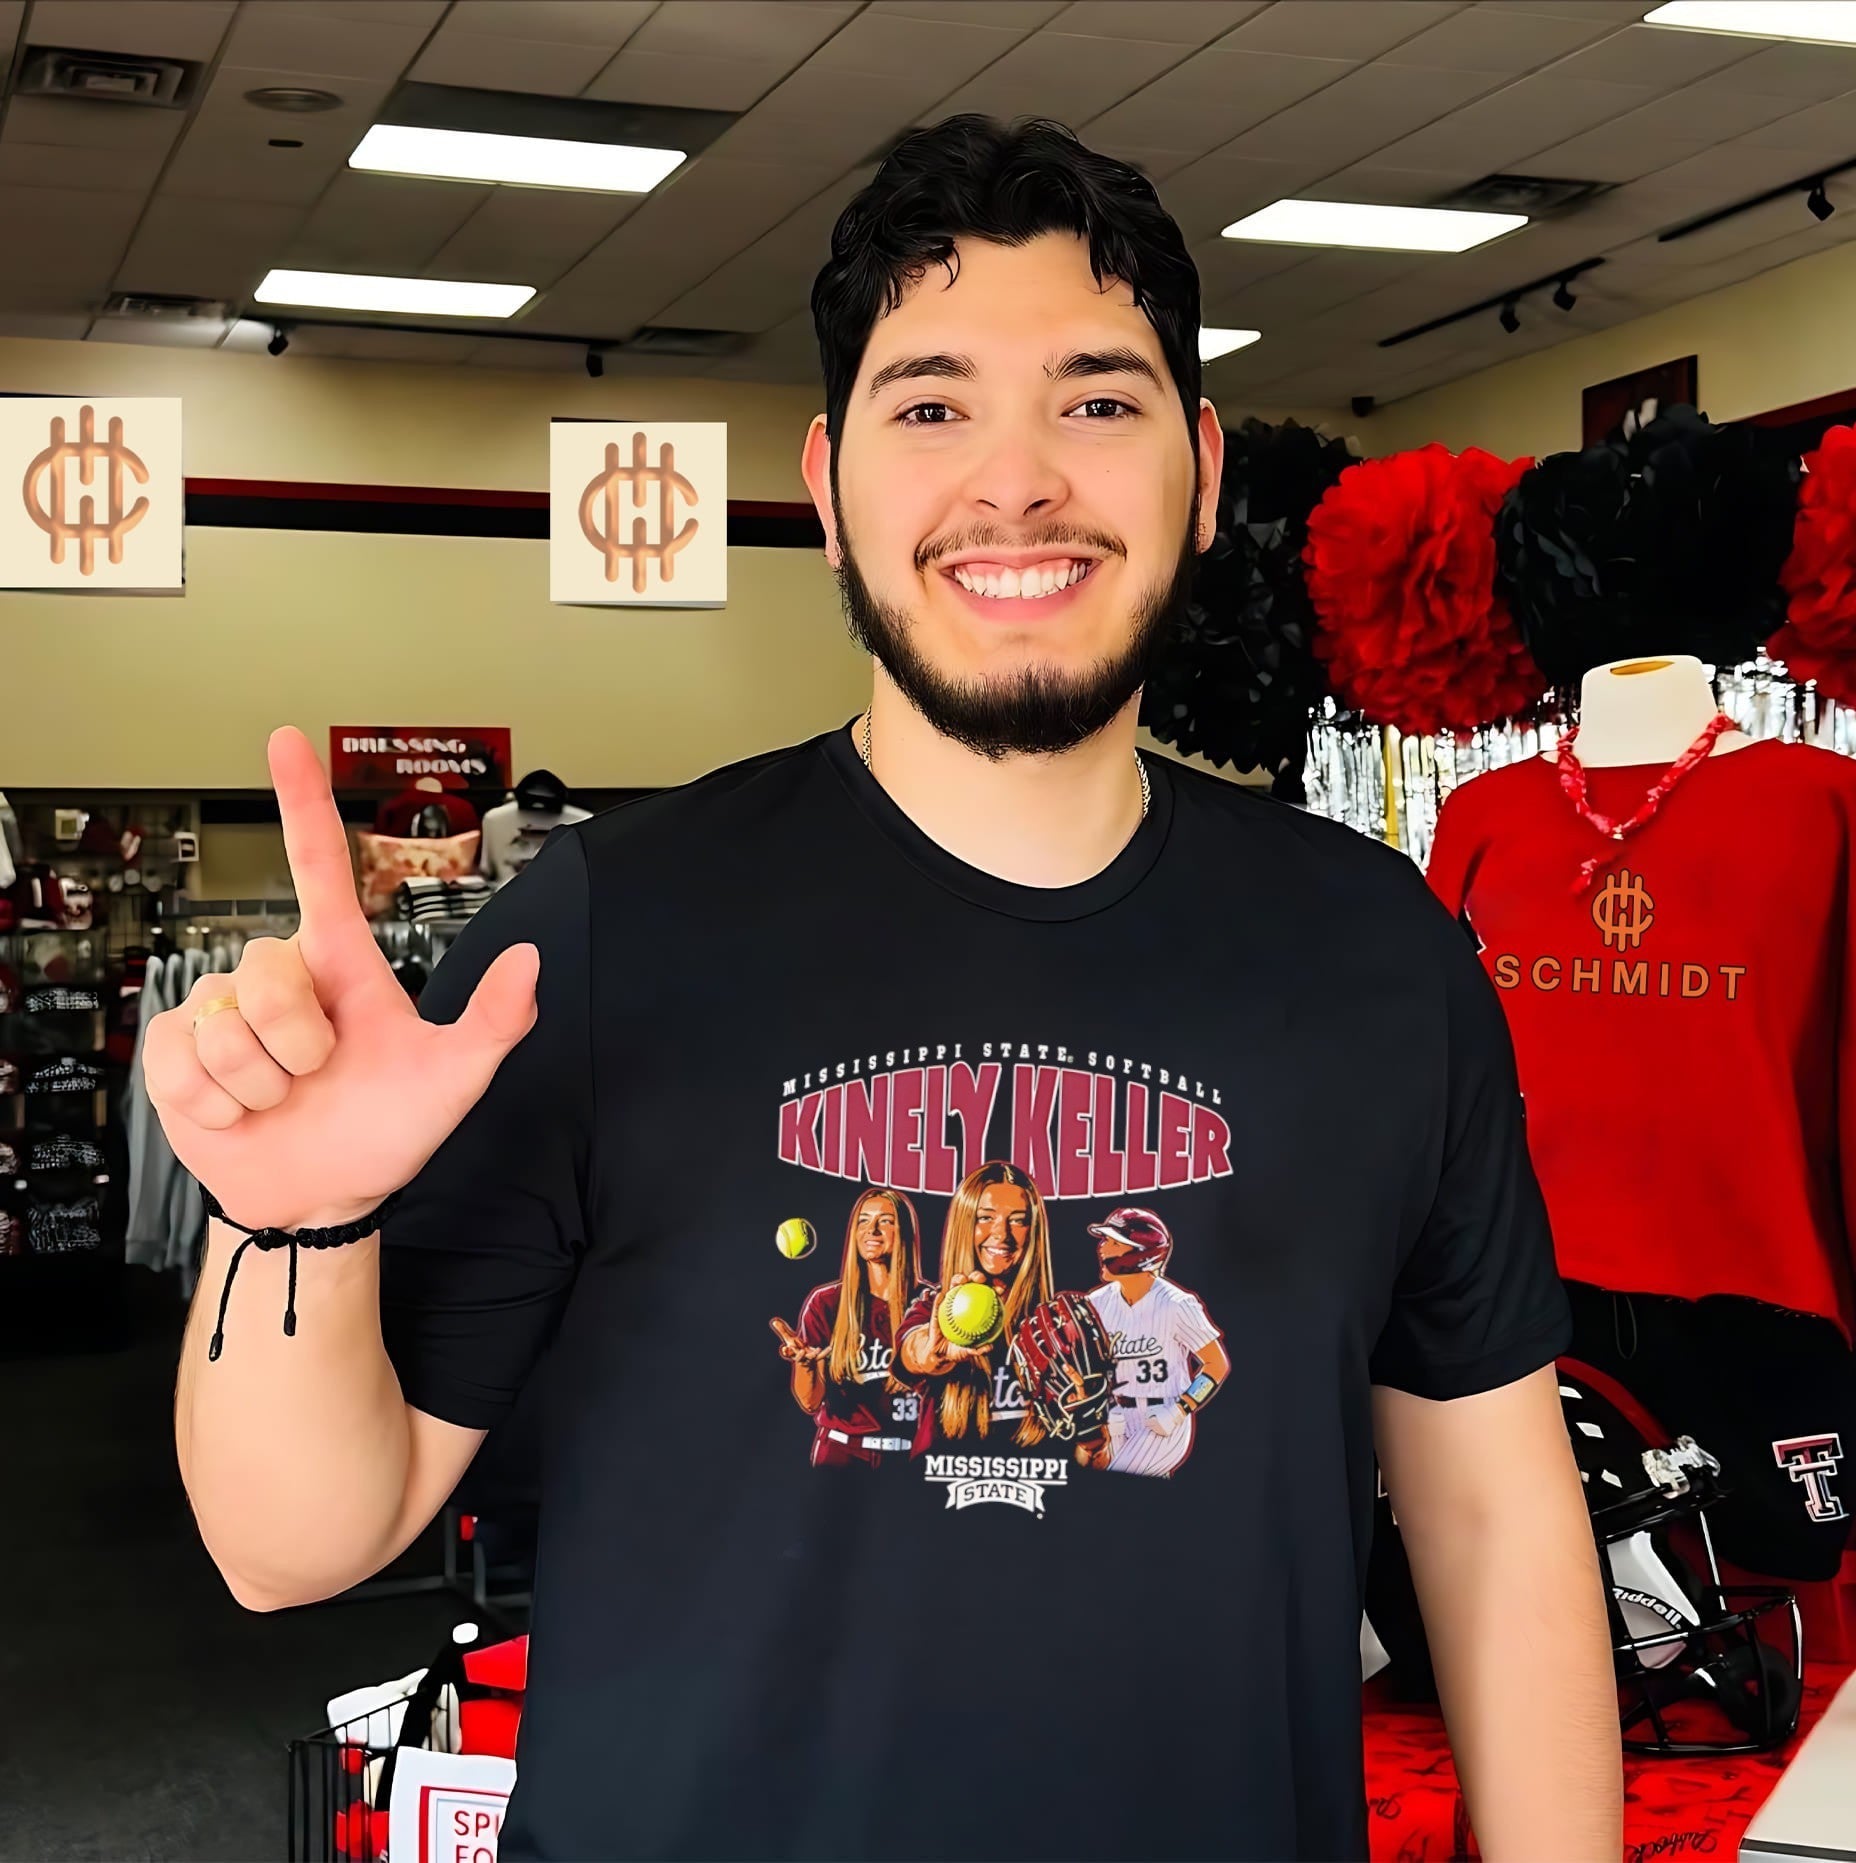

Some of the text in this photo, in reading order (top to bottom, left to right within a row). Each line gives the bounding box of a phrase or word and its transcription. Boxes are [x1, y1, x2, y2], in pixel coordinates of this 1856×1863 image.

[342, 737, 467, 754] DRESSING
[396, 758, 487, 775] ROOMS
[1493, 953, 1747, 1000] SCHMIDT
[783, 1043, 1221, 1105] MISSISSIPPI STATE SOFTBALL
[778, 1061, 1234, 1200] KINELY KELLER
[1136, 1359, 1168, 1383] 33
[892, 1398, 918, 1421] 33
[925, 1455, 1068, 1479] MISSISSIPPI
[964, 1484, 1027, 1503] STATE
